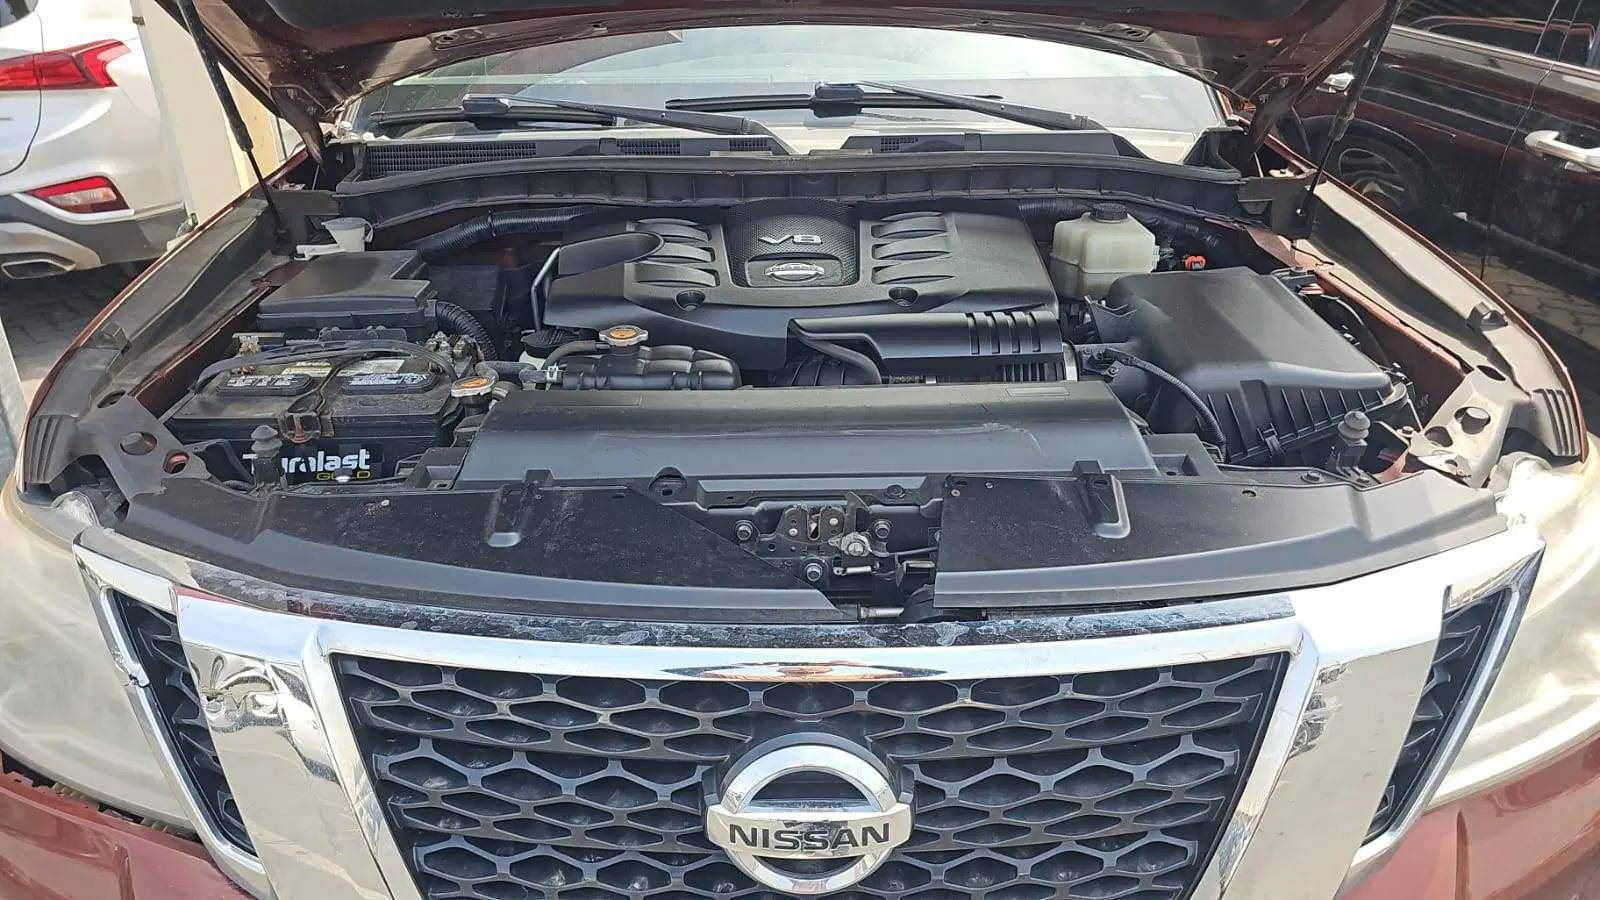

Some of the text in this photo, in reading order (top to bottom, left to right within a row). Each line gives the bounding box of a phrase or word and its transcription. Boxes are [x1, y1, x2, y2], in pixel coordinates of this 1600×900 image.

[242, 449, 371, 473] ralast
[316, 470, 371, 480] GD
[729, 822, 890, 850] NISSAN
